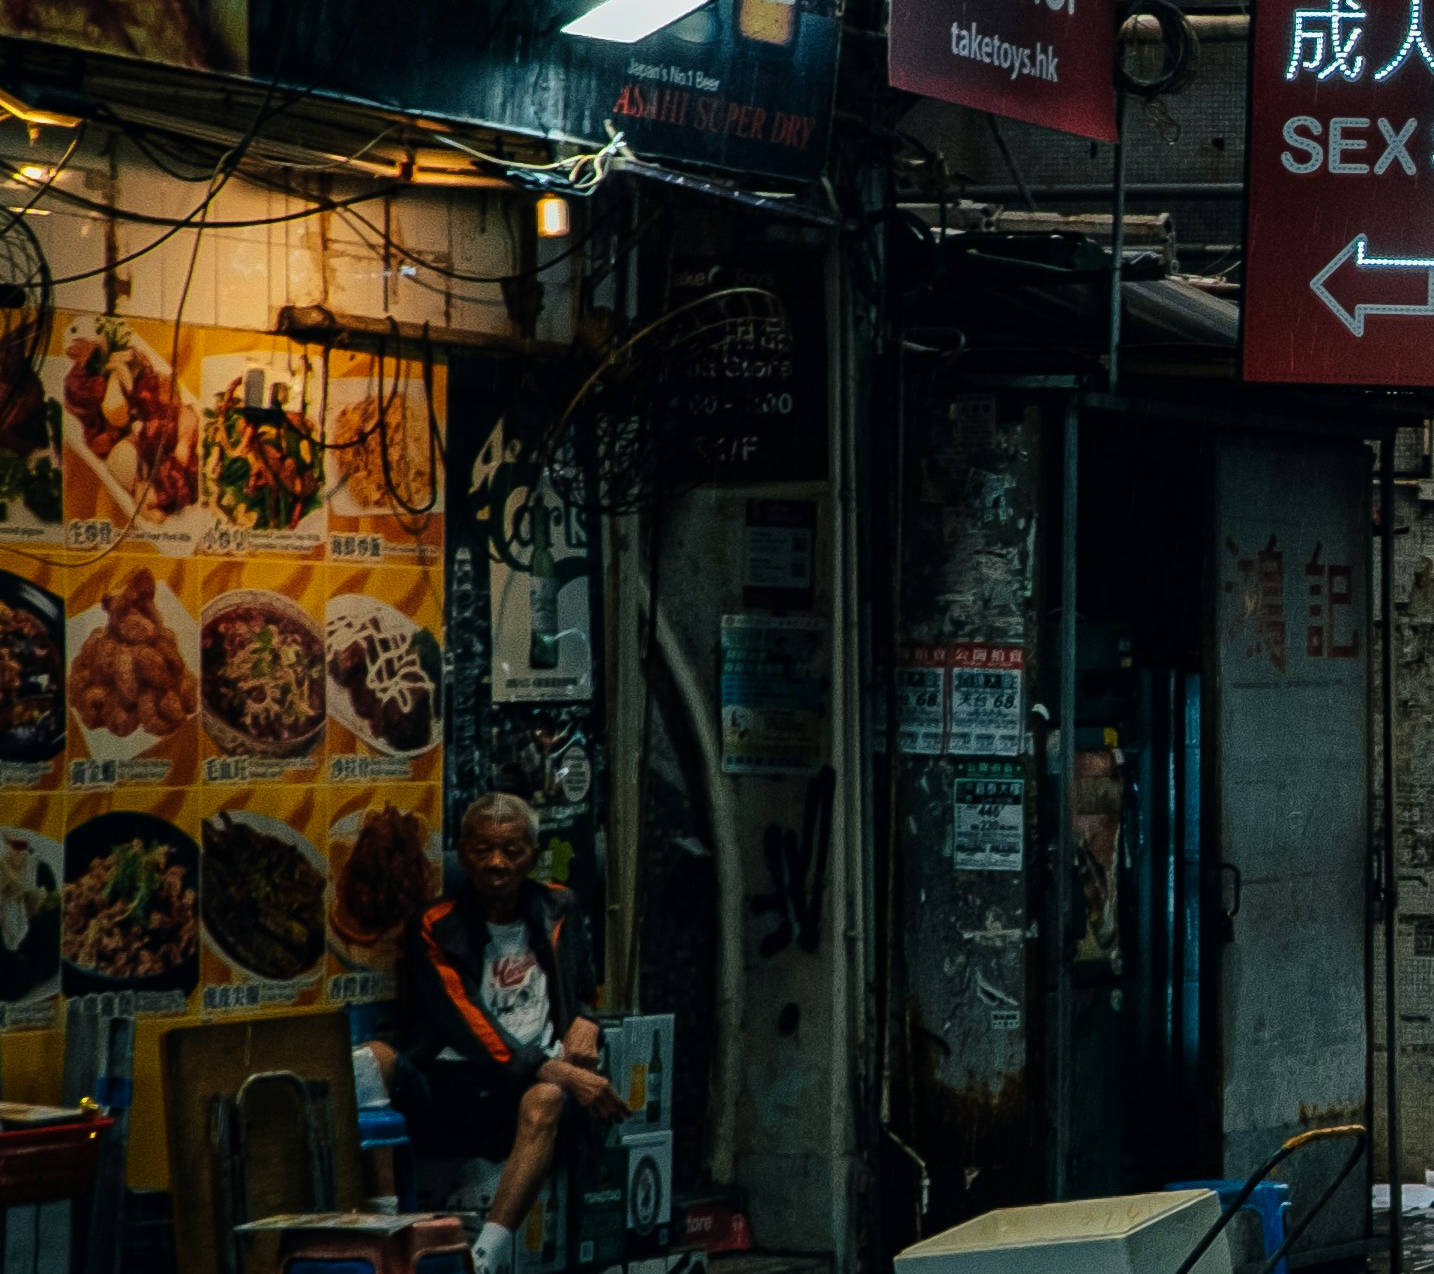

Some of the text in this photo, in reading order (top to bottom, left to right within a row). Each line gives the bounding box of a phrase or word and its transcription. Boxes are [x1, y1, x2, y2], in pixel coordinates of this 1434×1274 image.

[695, 70, 721, 92] Beer
[950, 21, 1059, 84] taketoys.hk
[613, 83, 689, 126] ASAHI
[693, 94, 766, 140] SUPER
[1280, 116, 1419, 176] SEX
